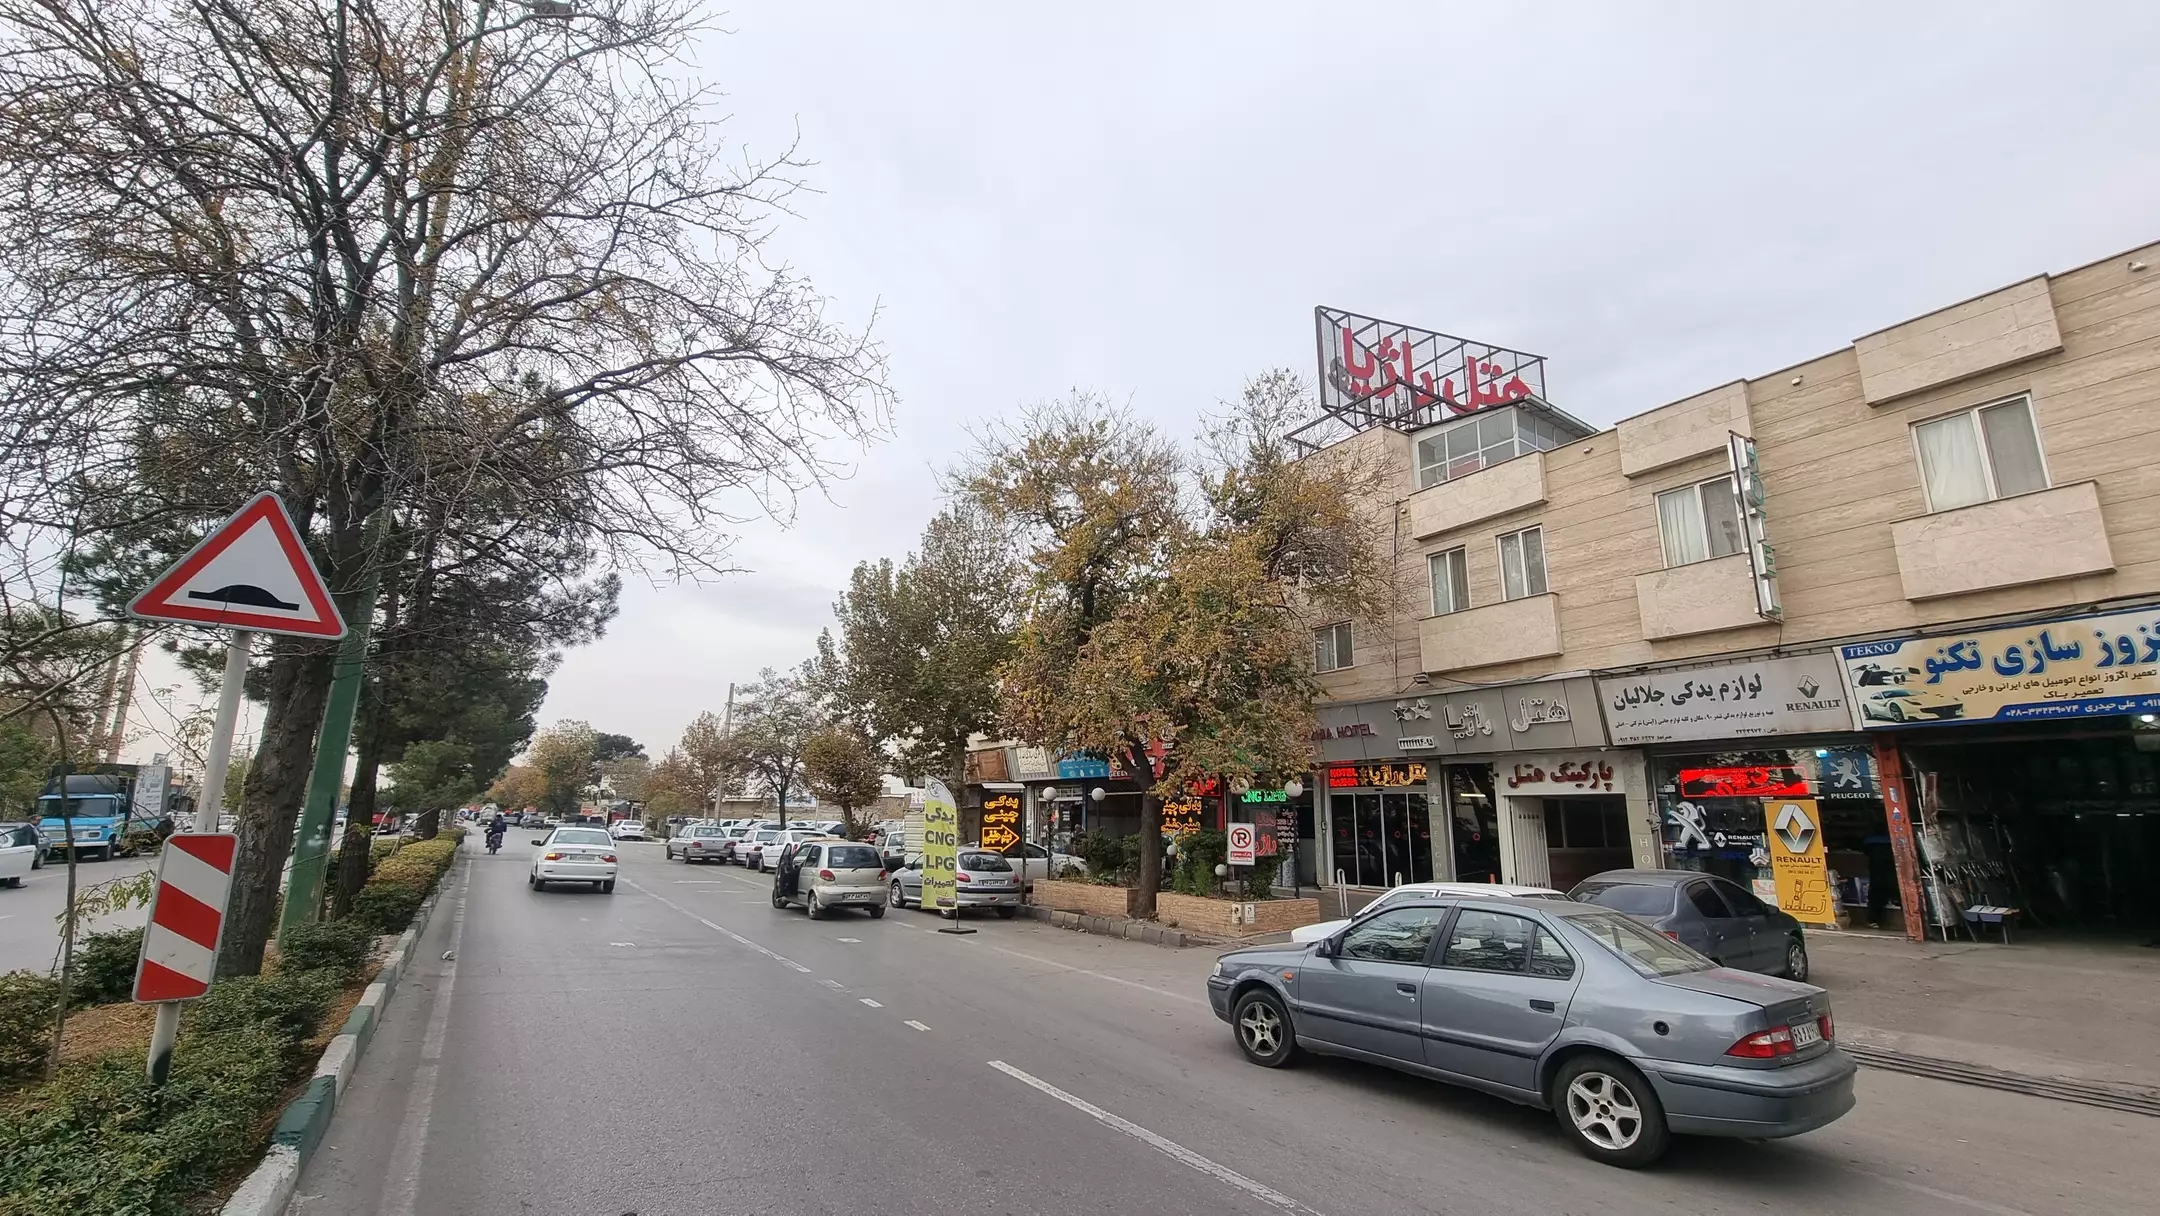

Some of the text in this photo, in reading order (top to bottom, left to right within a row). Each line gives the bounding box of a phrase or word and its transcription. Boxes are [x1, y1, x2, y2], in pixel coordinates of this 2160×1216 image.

[1342, 327, 1531, 415] هتل راژیا
[1848, 643, 1895, 657] TEKNO
[1994, 630, 2080, 676] سازی
[1925, 640, 1982, 684] تکنو
[2078, 674, 2100, 686] انواع
[2104, 670, 2128, 682] اگزوز
[2132, 669, 2157, 680] تعمیر
[1996, 681, 2021, 692] ایرانی
[2023, 680, 2039, 689] های
[2042, 676, 2076, 688] اتومبیل
[1614, 673, 1763, 711] لوازم یدکی جلالیان
[1962, 684, 1986, 695] خارجی
[2072, 688, 2104, 698] تعمیر
[1786, 699, 1841, 712] RENAULT
[2085, 703, 2116, 712] حیدری
[2118, 700, 2136, 710] علی
[1444, 697, 1570, 739] هتل راژیا
[1337, 723, 1376, 738] HOTEL
[1508, 760, 1614, 792] پارکینگ هتل
[925, 807, 955, 825] یدکی
[925, 830, 955, 847] CNG
[925, 855, 955, 871] LPG
[1776, 856, 1822, 864] RENAULT
[924, 876, 955, 889] تعمیرات
